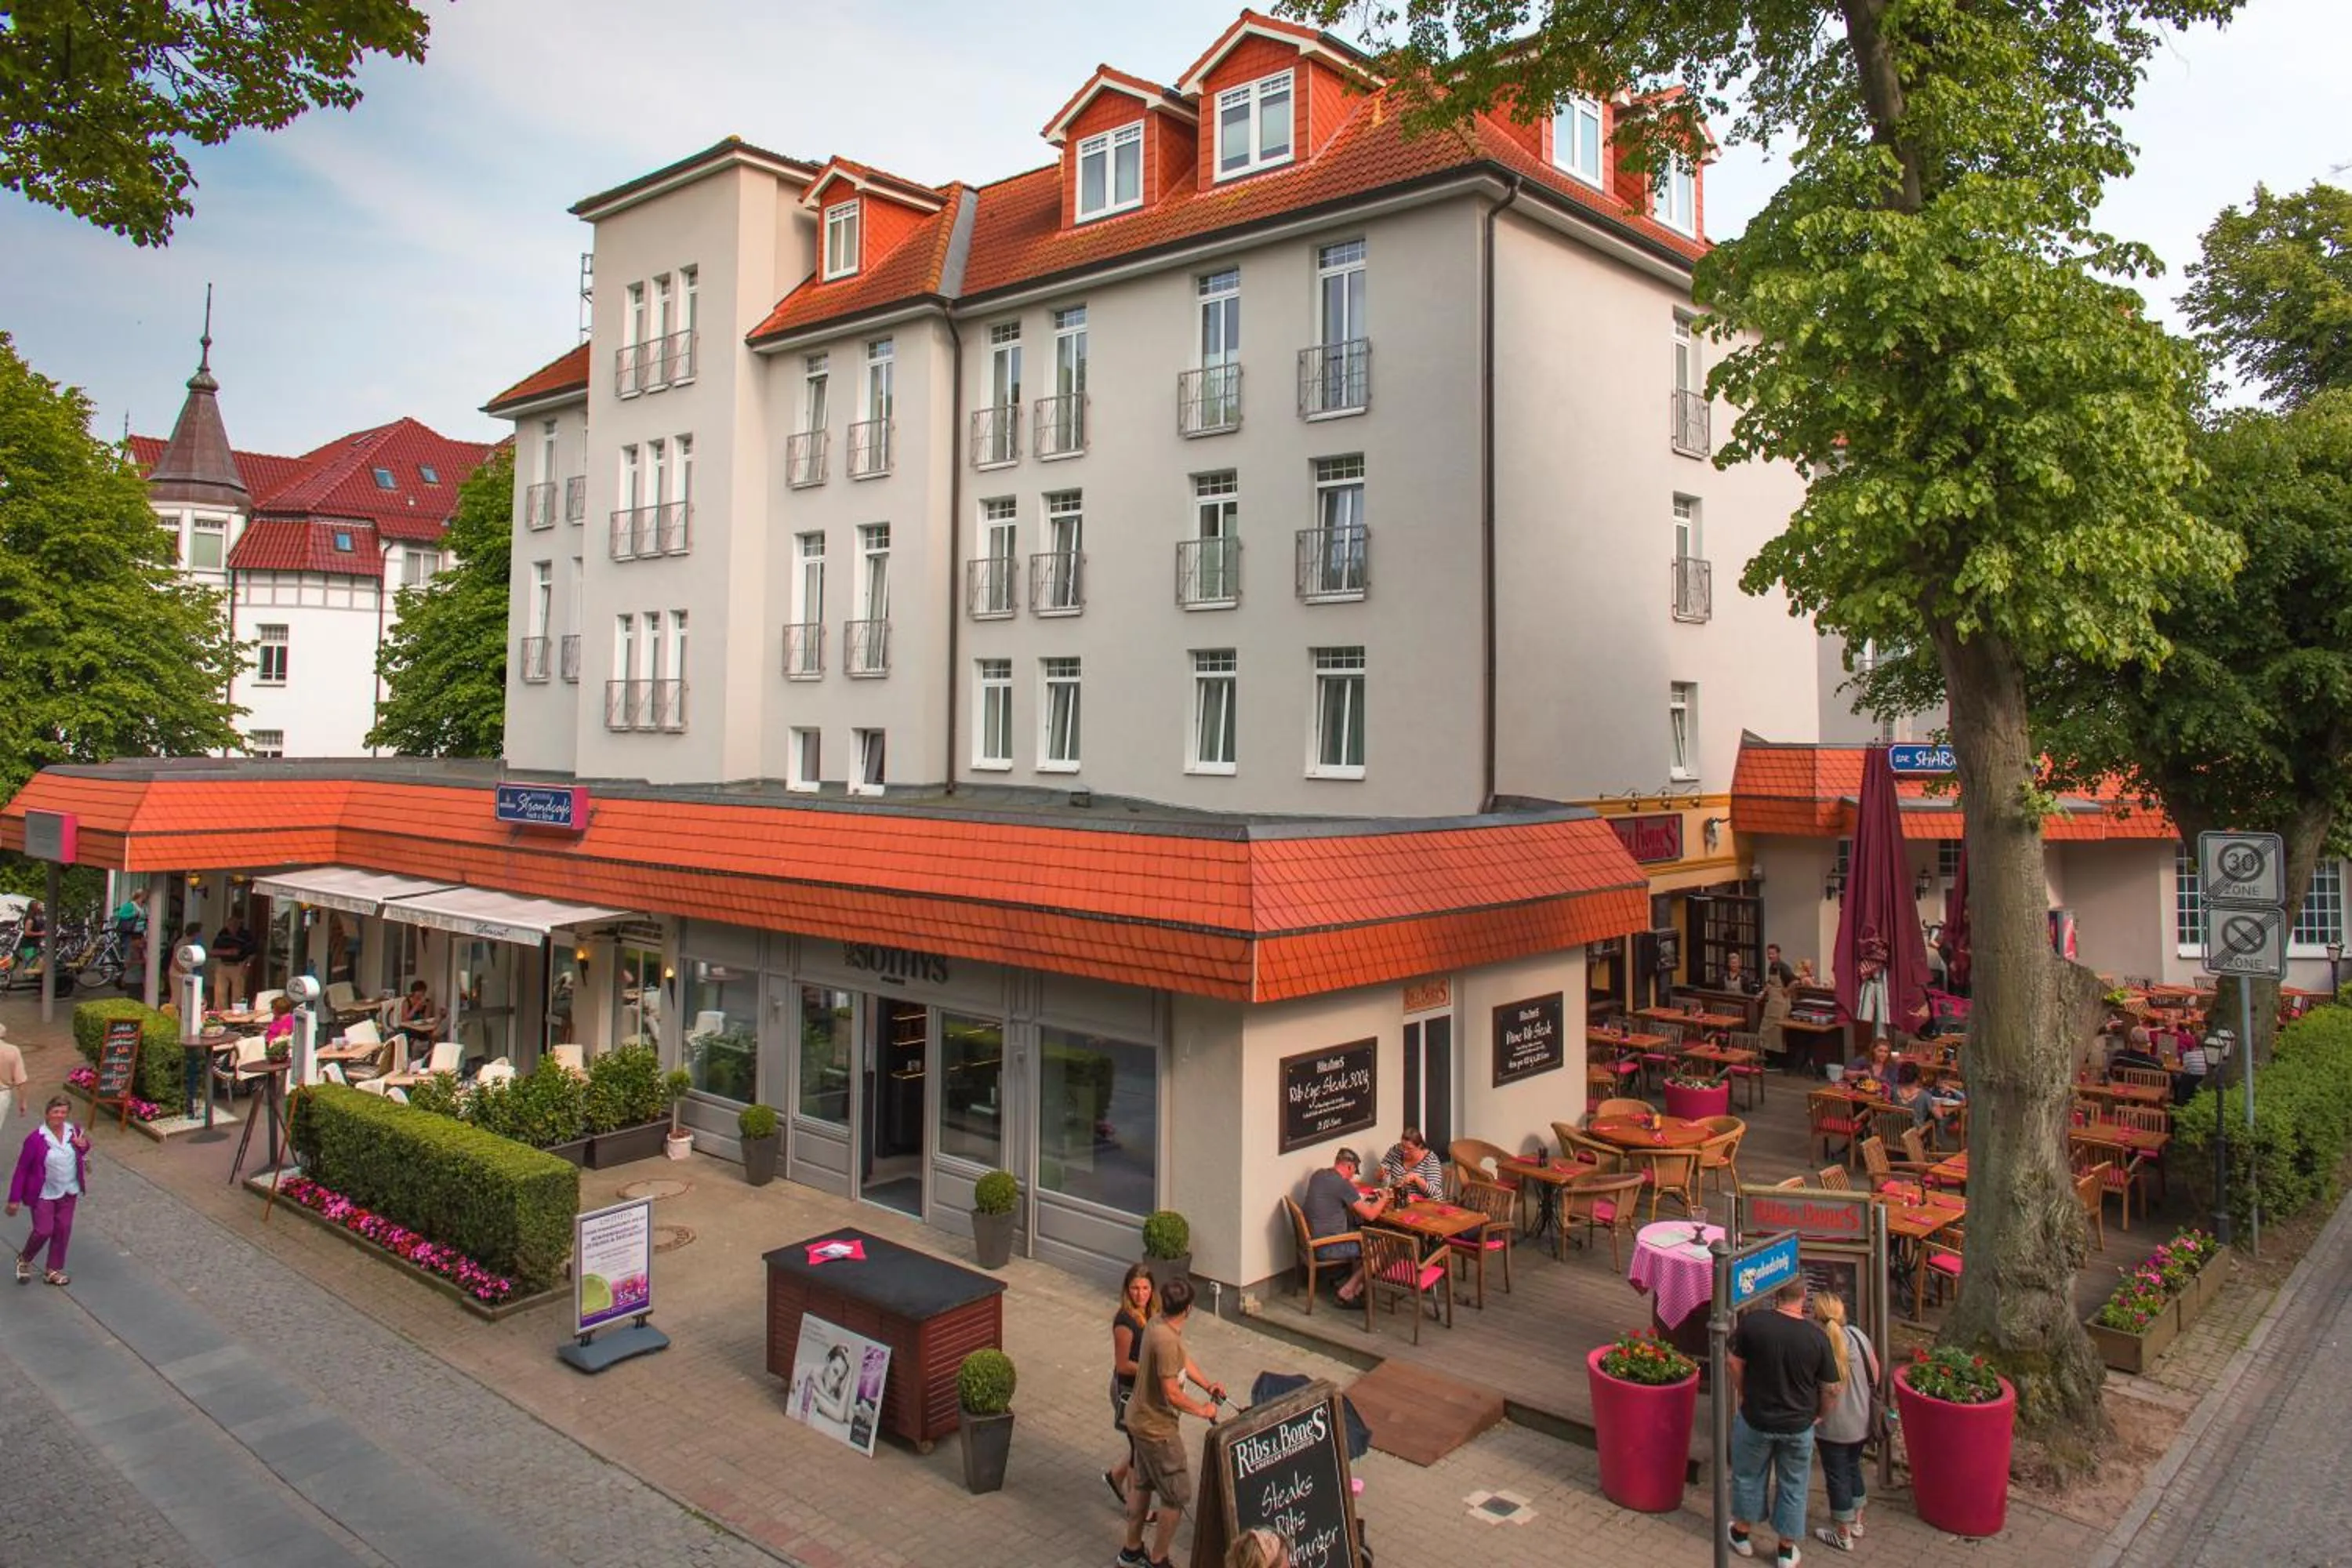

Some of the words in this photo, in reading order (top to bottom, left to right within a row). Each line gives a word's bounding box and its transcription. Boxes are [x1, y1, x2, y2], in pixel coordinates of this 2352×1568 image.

[2227, 852, 2256, 872] 30
[2224, 884, 2261, 896] ZONE
[852, 945, 949, 984] SOTHYS
[2227, 956, 2263, 970] ZONE
[1322, 1072, 1348, 1095] Steak
[1236, 1438, 1270, 1479] Ribs
[1272, 1436, 1279, 1452] &
[1261, 1471, 1313, 1517] Steaks
[1274, 1507, 1305, 1538] Ribs
